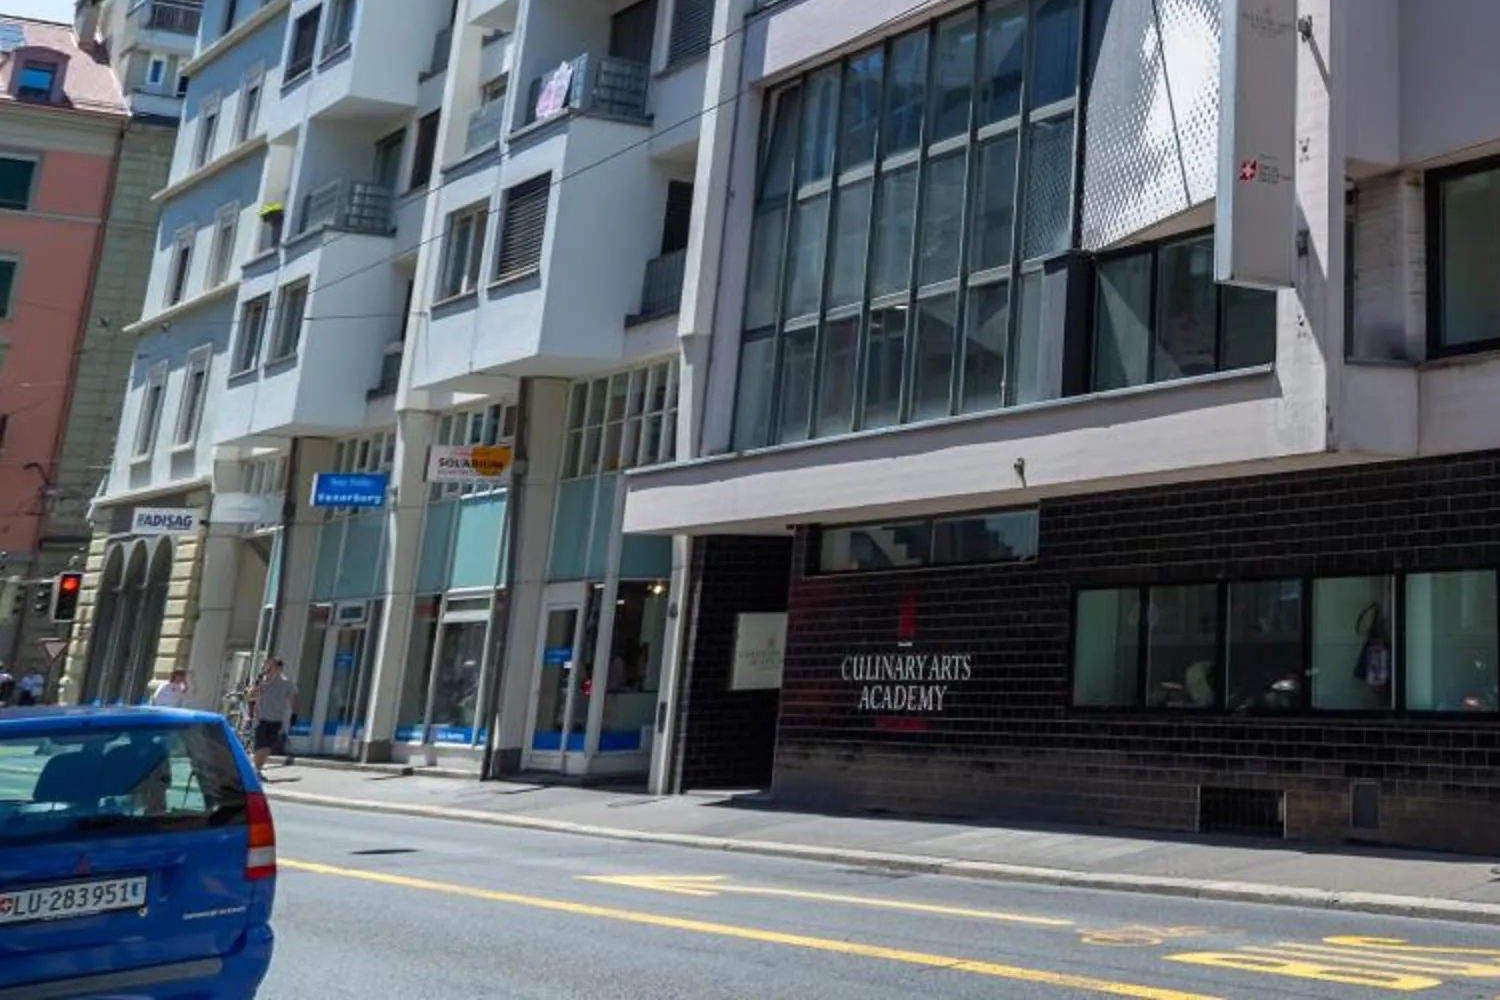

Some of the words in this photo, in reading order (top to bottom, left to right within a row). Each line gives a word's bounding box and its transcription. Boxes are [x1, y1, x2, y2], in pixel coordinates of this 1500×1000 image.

[841, 655, 926, 681] CULINARY
[927, 655, 971, 681] ARTS
[858, 685, 948, 711] ACADEMY
